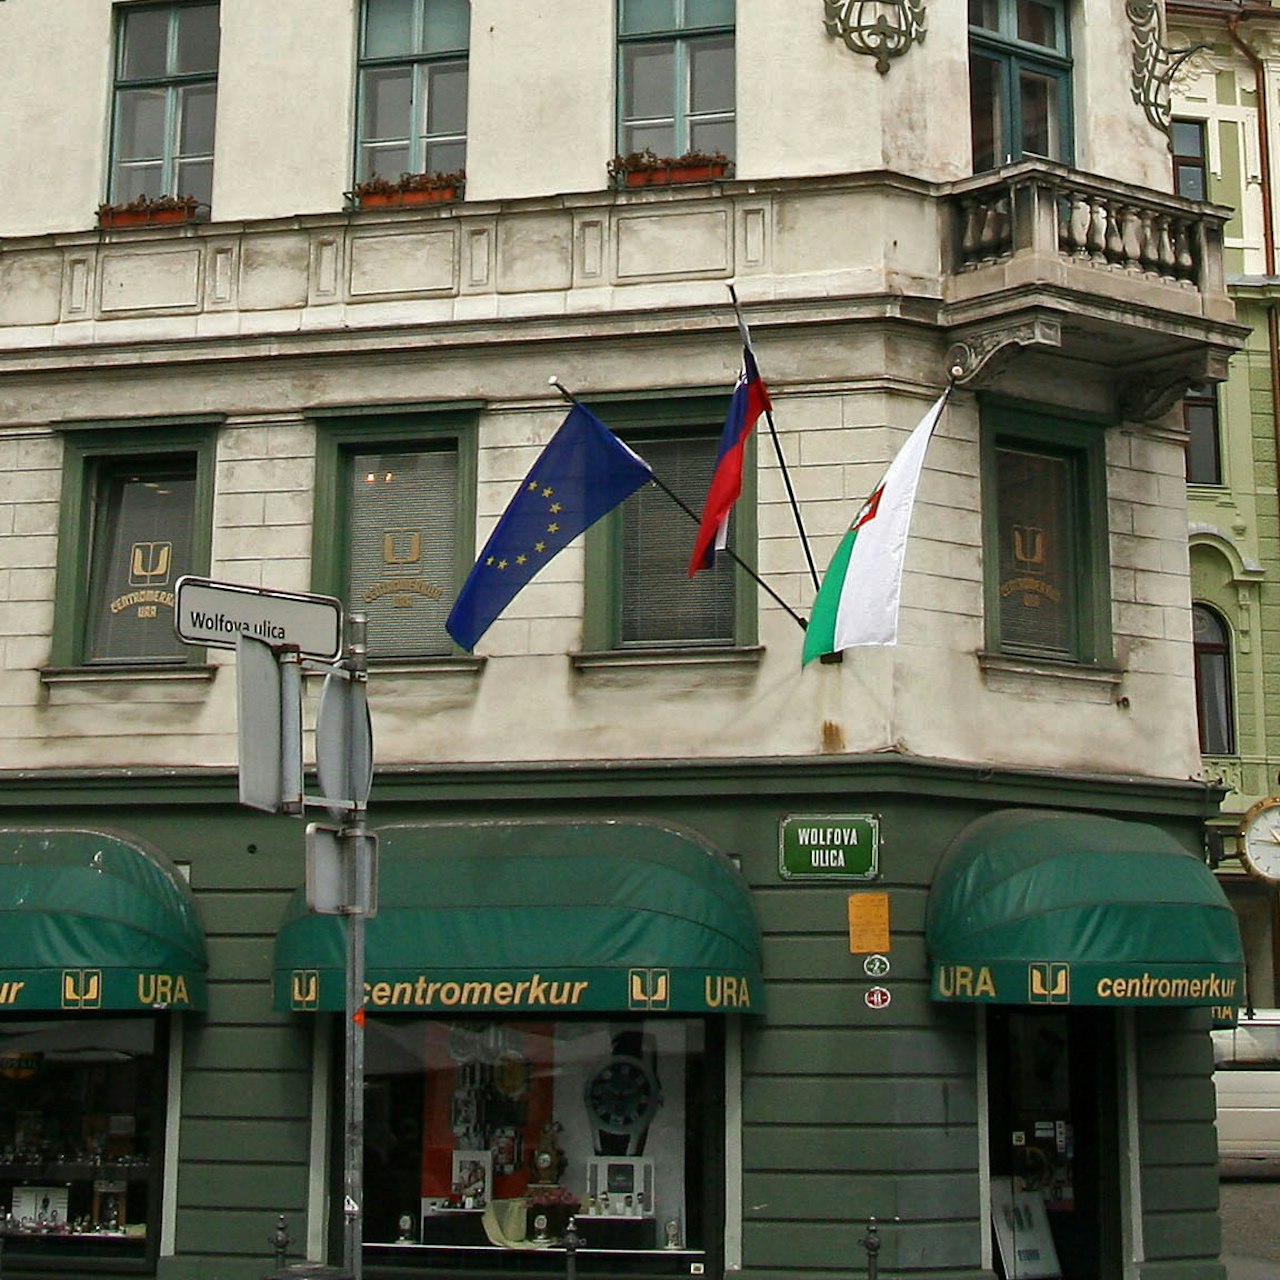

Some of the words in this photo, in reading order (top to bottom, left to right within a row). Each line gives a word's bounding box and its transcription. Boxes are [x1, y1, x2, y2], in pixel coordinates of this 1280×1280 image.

[254, 619, 285, 639] ulica
[797, 828, 858, 846] WOLFOVA
[810, 849, 846, 867] ULICA
[136, 973, 190, 1005] URA
[704, 974, 751, 1008] URA
[938, 965, 997, 998] URA
[1096, 972, 1238, 1000] centromerkur
